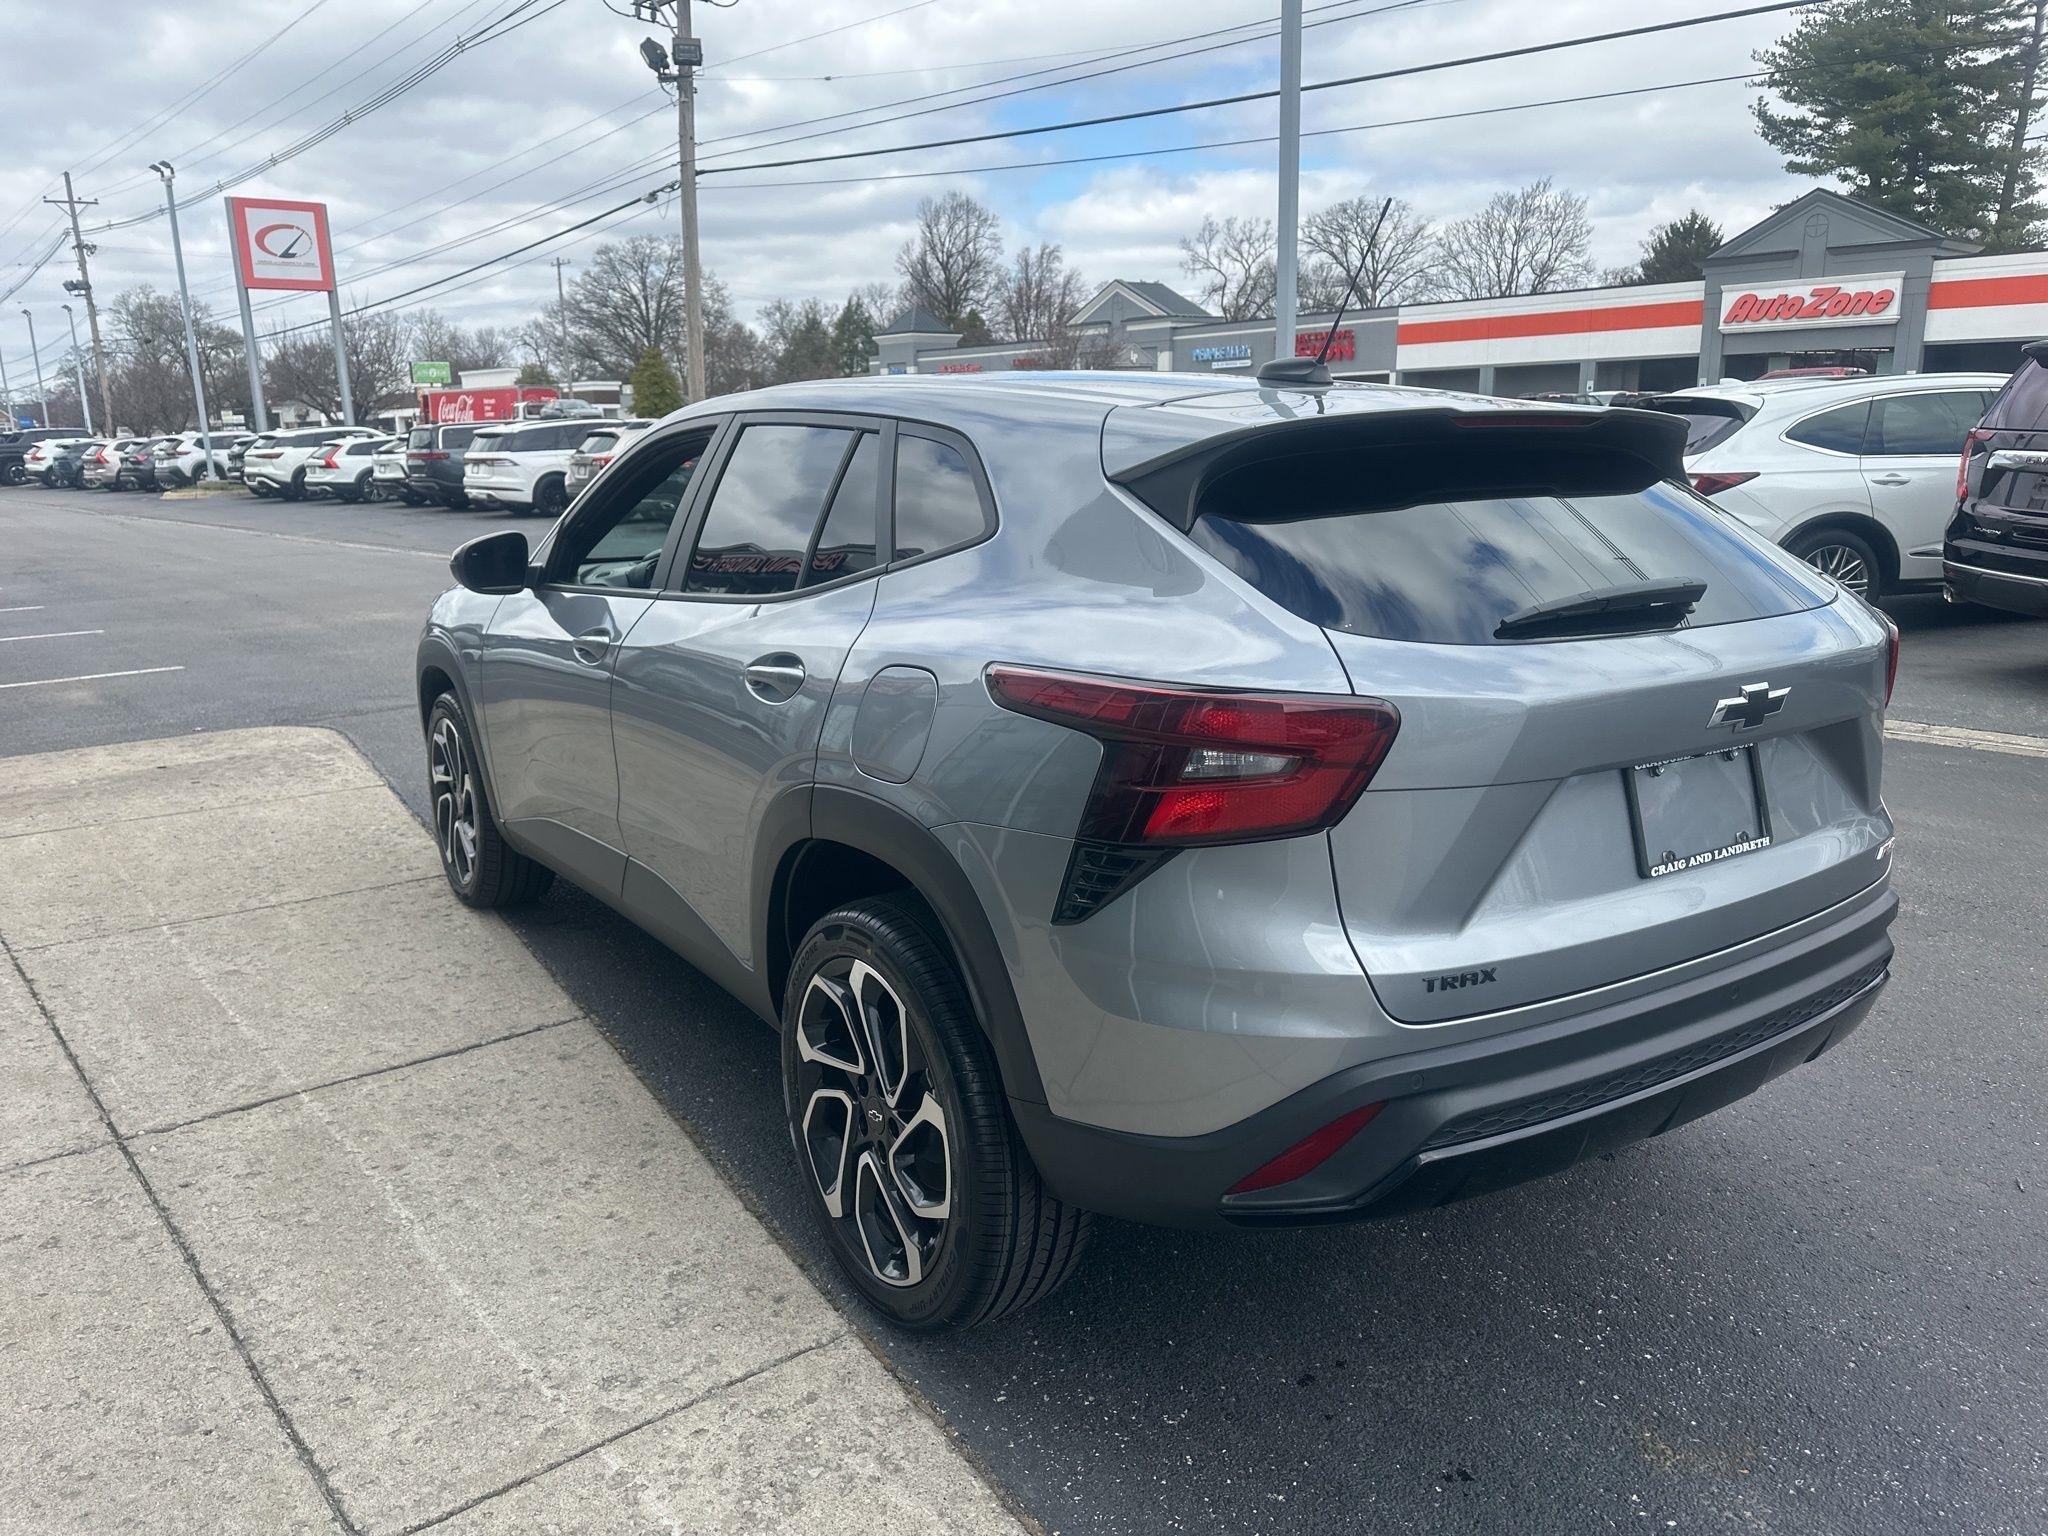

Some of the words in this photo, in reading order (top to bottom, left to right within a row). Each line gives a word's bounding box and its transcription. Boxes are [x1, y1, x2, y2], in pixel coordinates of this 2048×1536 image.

[1722, 286, 1896, 324] AutoZone
[1650, 859, 1687, 877] CRAIG
[1688, 851, 1713, 868] AND
[1714, 836, 1771, 860] LANDRETH
[1422, 967, 1497, 993] TRAX
